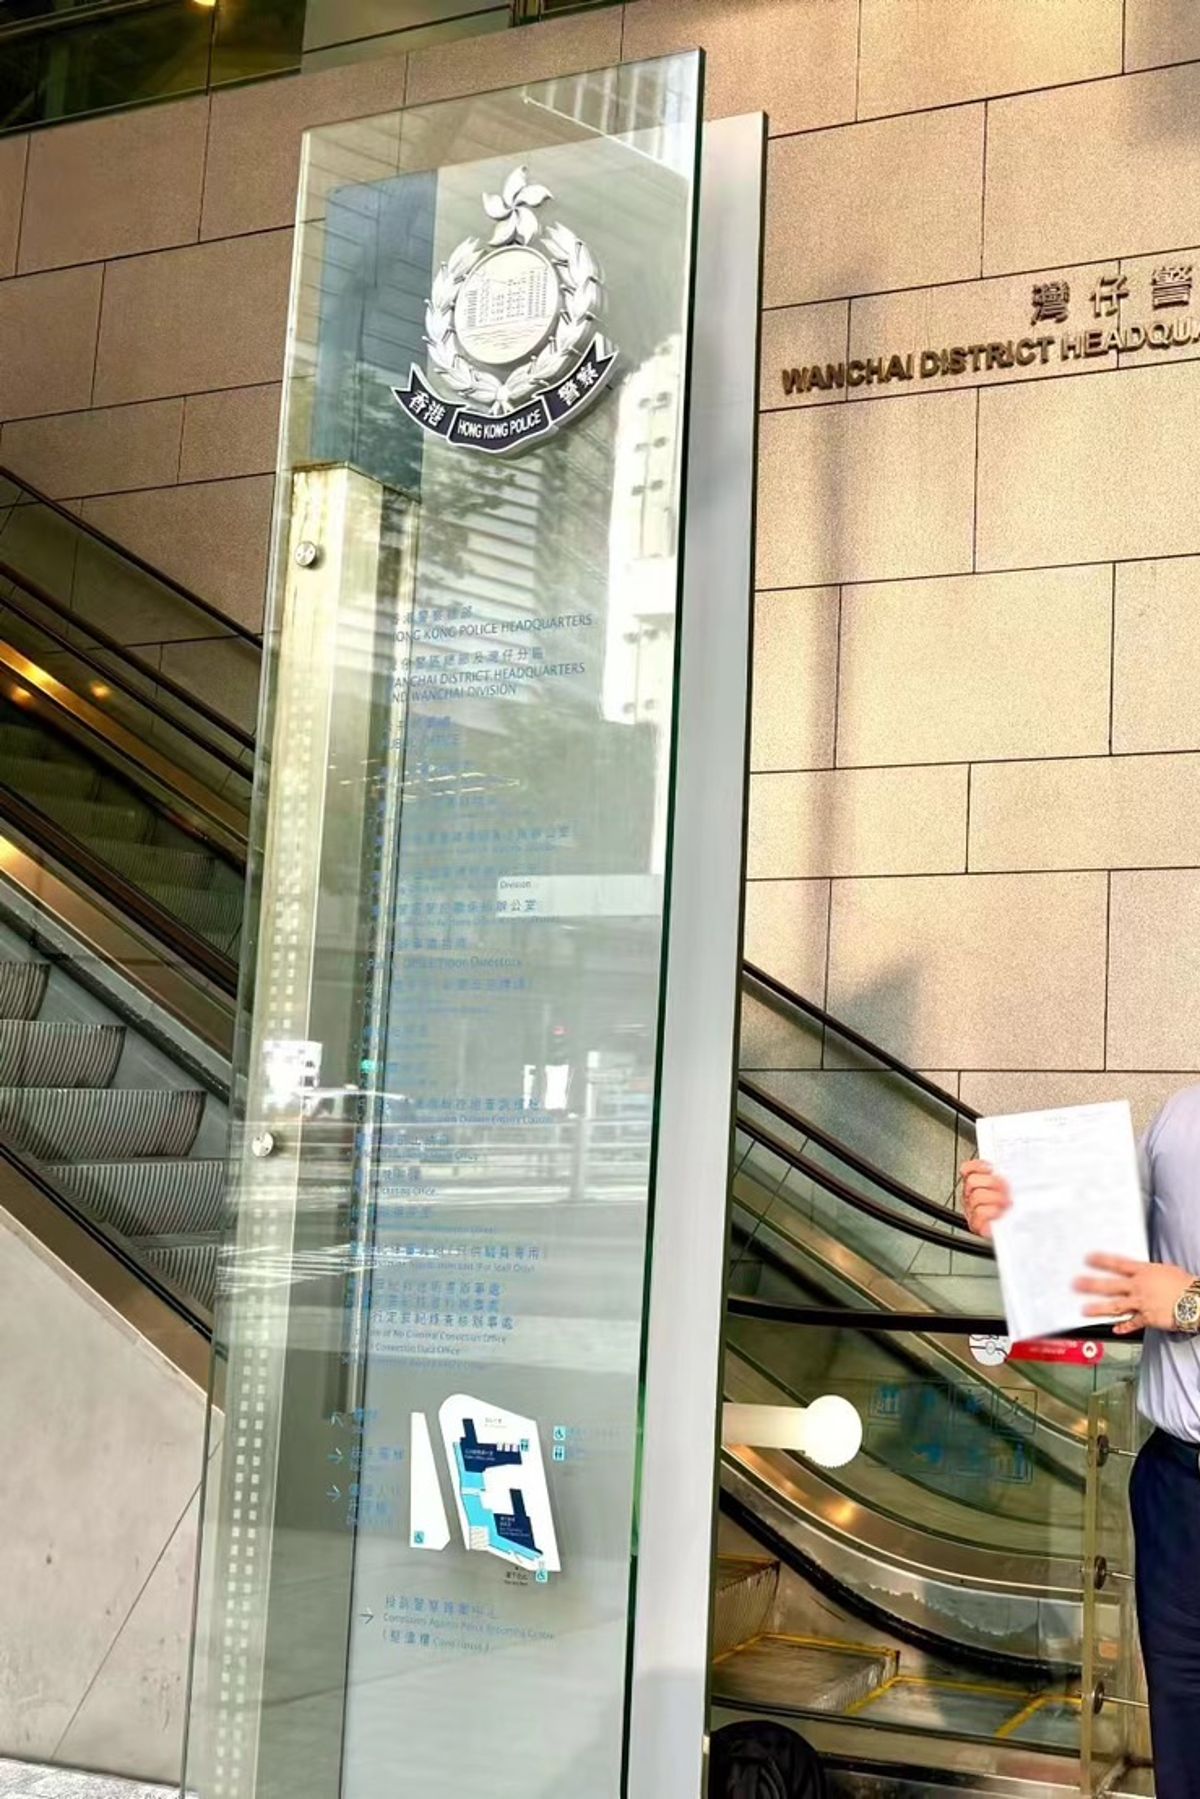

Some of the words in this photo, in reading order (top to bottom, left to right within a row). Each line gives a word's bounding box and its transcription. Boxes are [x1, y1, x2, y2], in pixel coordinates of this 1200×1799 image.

[781, 352, 914, 396] WANCHAI
[919, 336, 1054, 379] DISTRICT
[556, 362, 599, 406] 警察
[408, 392, 446, 427] 香港
[457, 419, 482, 438] HONG
[484, 422, 509, 439] KONG
[510, 409, 541, 436] POLICE
[460, 623, 498, 637] POLICE
[501, 613, 592, 633] HEADQUARTERS
[440, 670, 490, 685] DISTRICT
[494, 662, 585, 681] HEADQUARTERS
